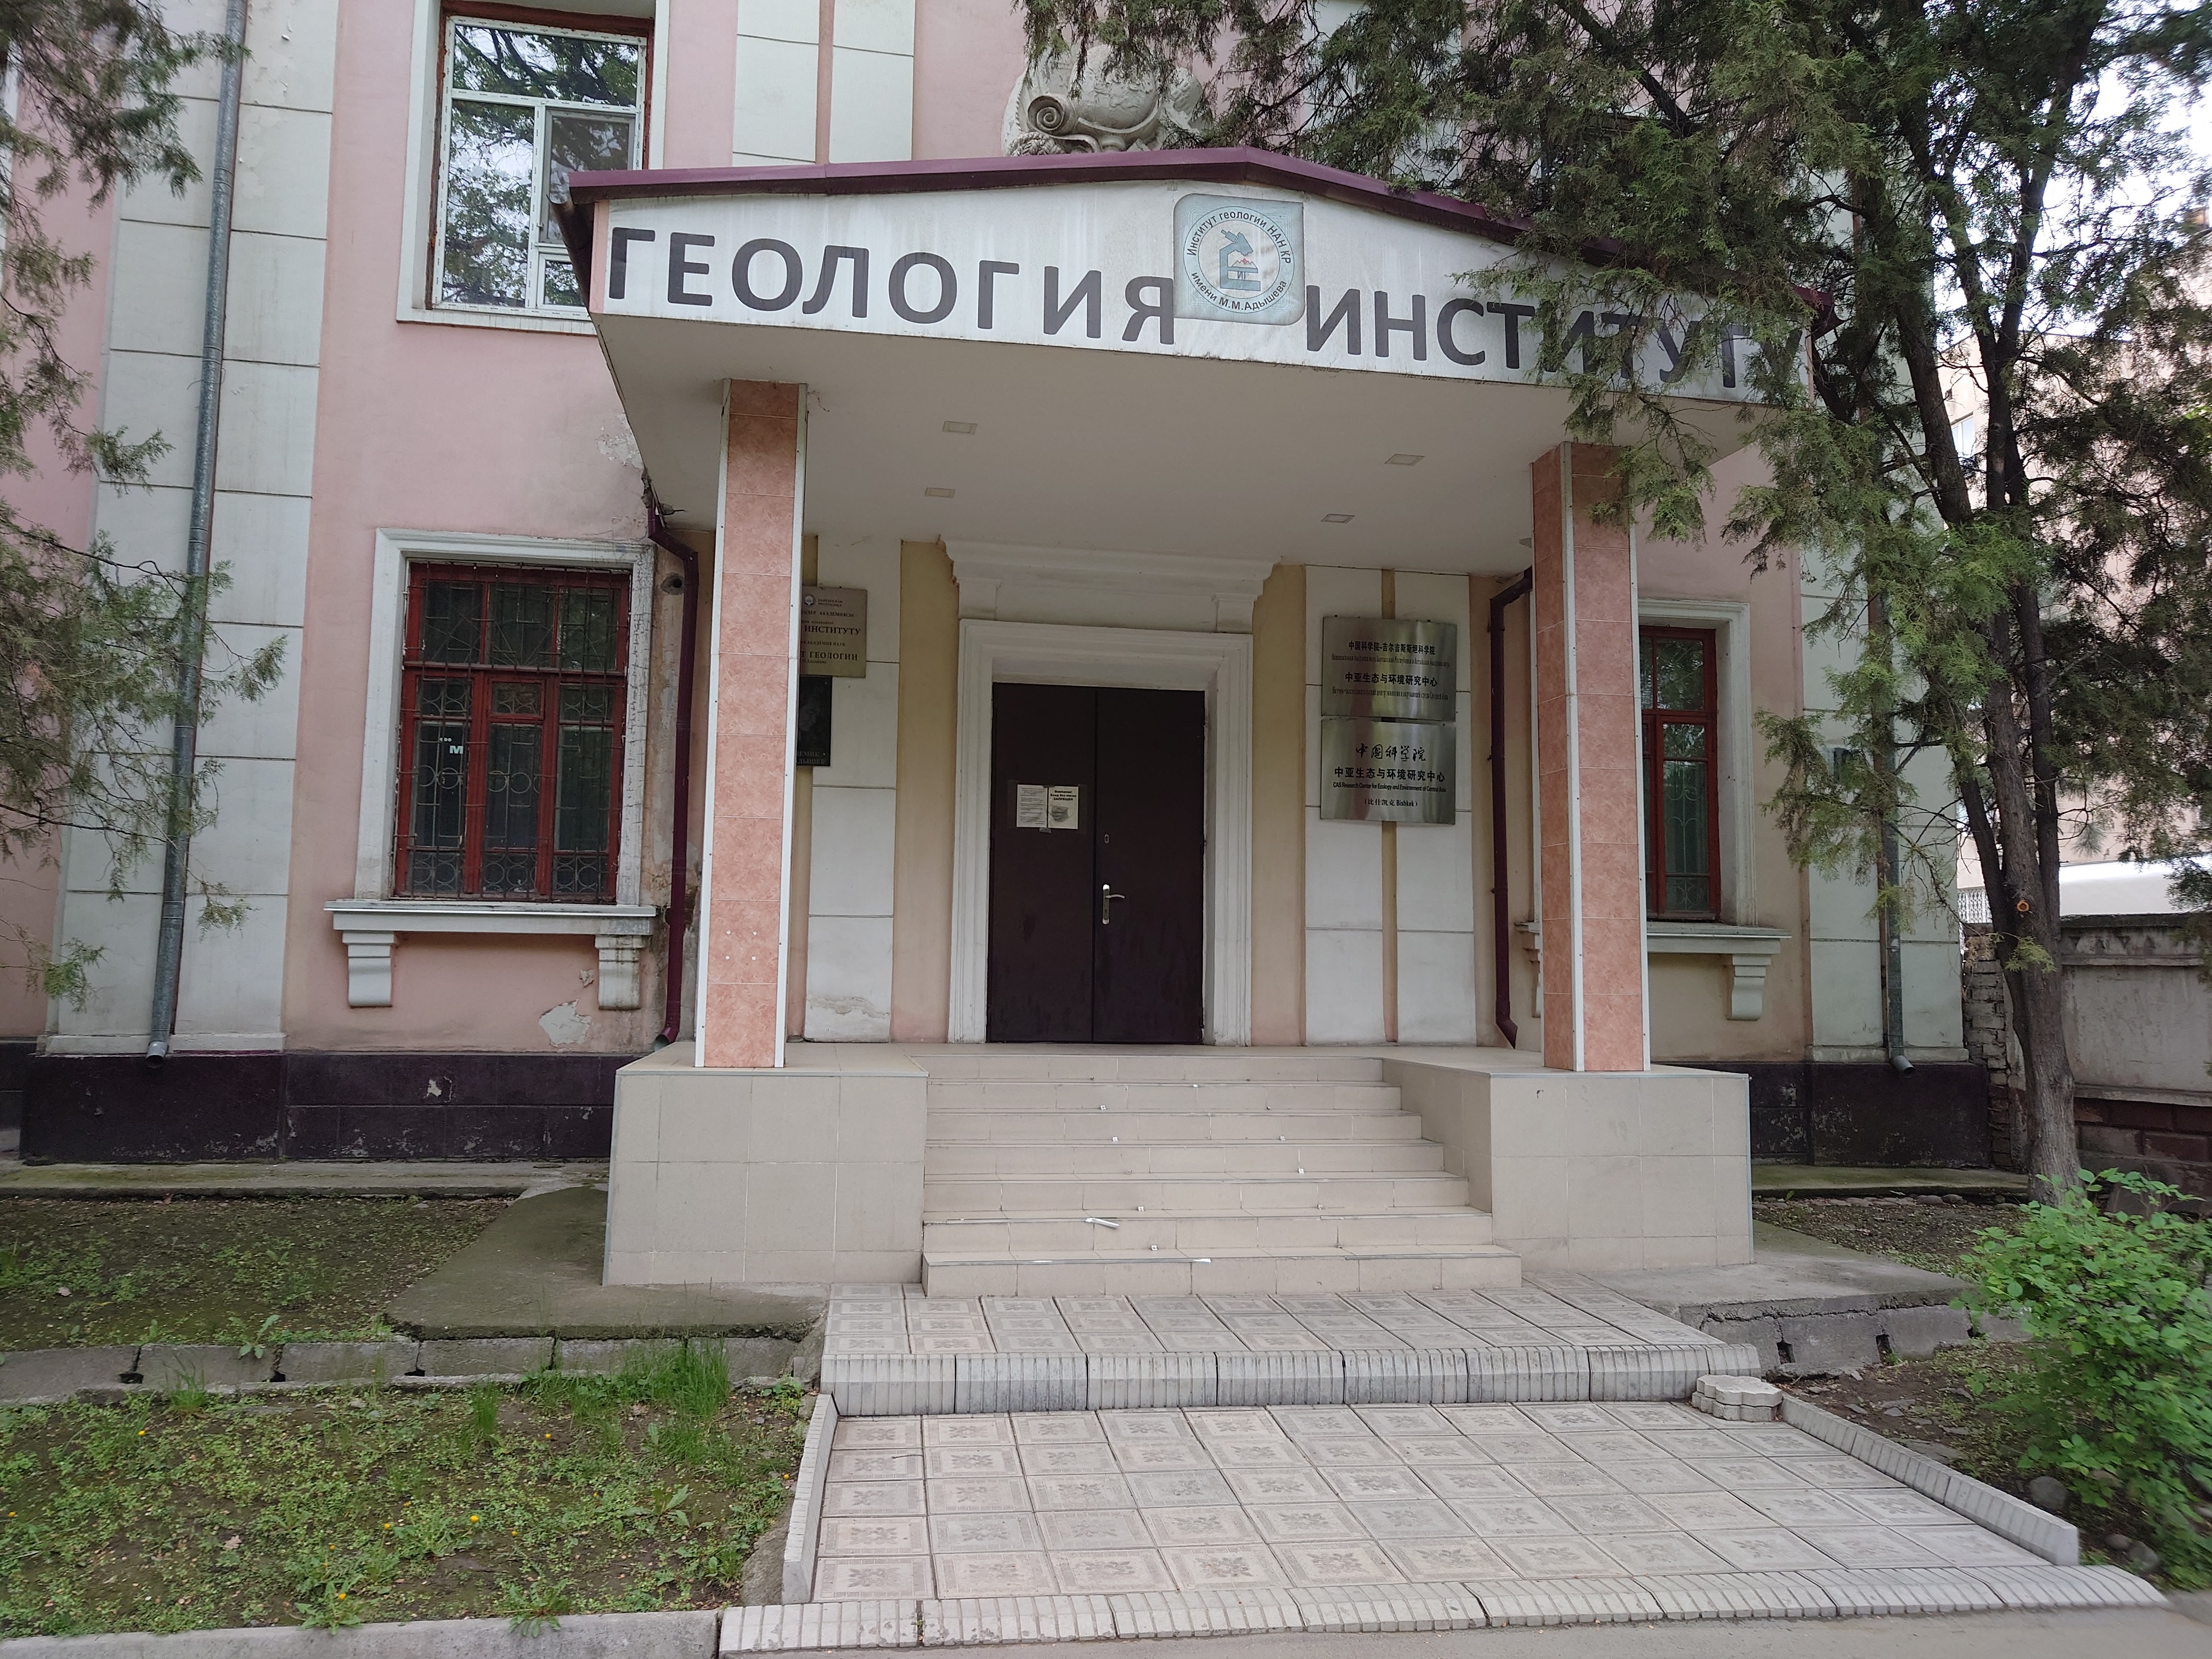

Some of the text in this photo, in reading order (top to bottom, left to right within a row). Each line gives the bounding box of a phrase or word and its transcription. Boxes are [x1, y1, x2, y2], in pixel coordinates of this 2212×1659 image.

[1187, 211, 1291, 264] Институт геологии НАН КР
[608, 226, 1175, 345] ГЕОЛОГИЯ
[1191, 272, 1287, 311] имени М.М.Адышева
[804, 625, 860, 635] ИНСТИТУТУ
[1348, 640, 1436, 655] 中国科学院-吉尔吉斯斯坦科学院
[810, 651, 857, 661] ГЕОЛОГИИ
[1345, 672, 1437, 687] 中亚生态与环境研究中心
[1334, 766, 1445, 782] 中亚生态与环境研究中心
